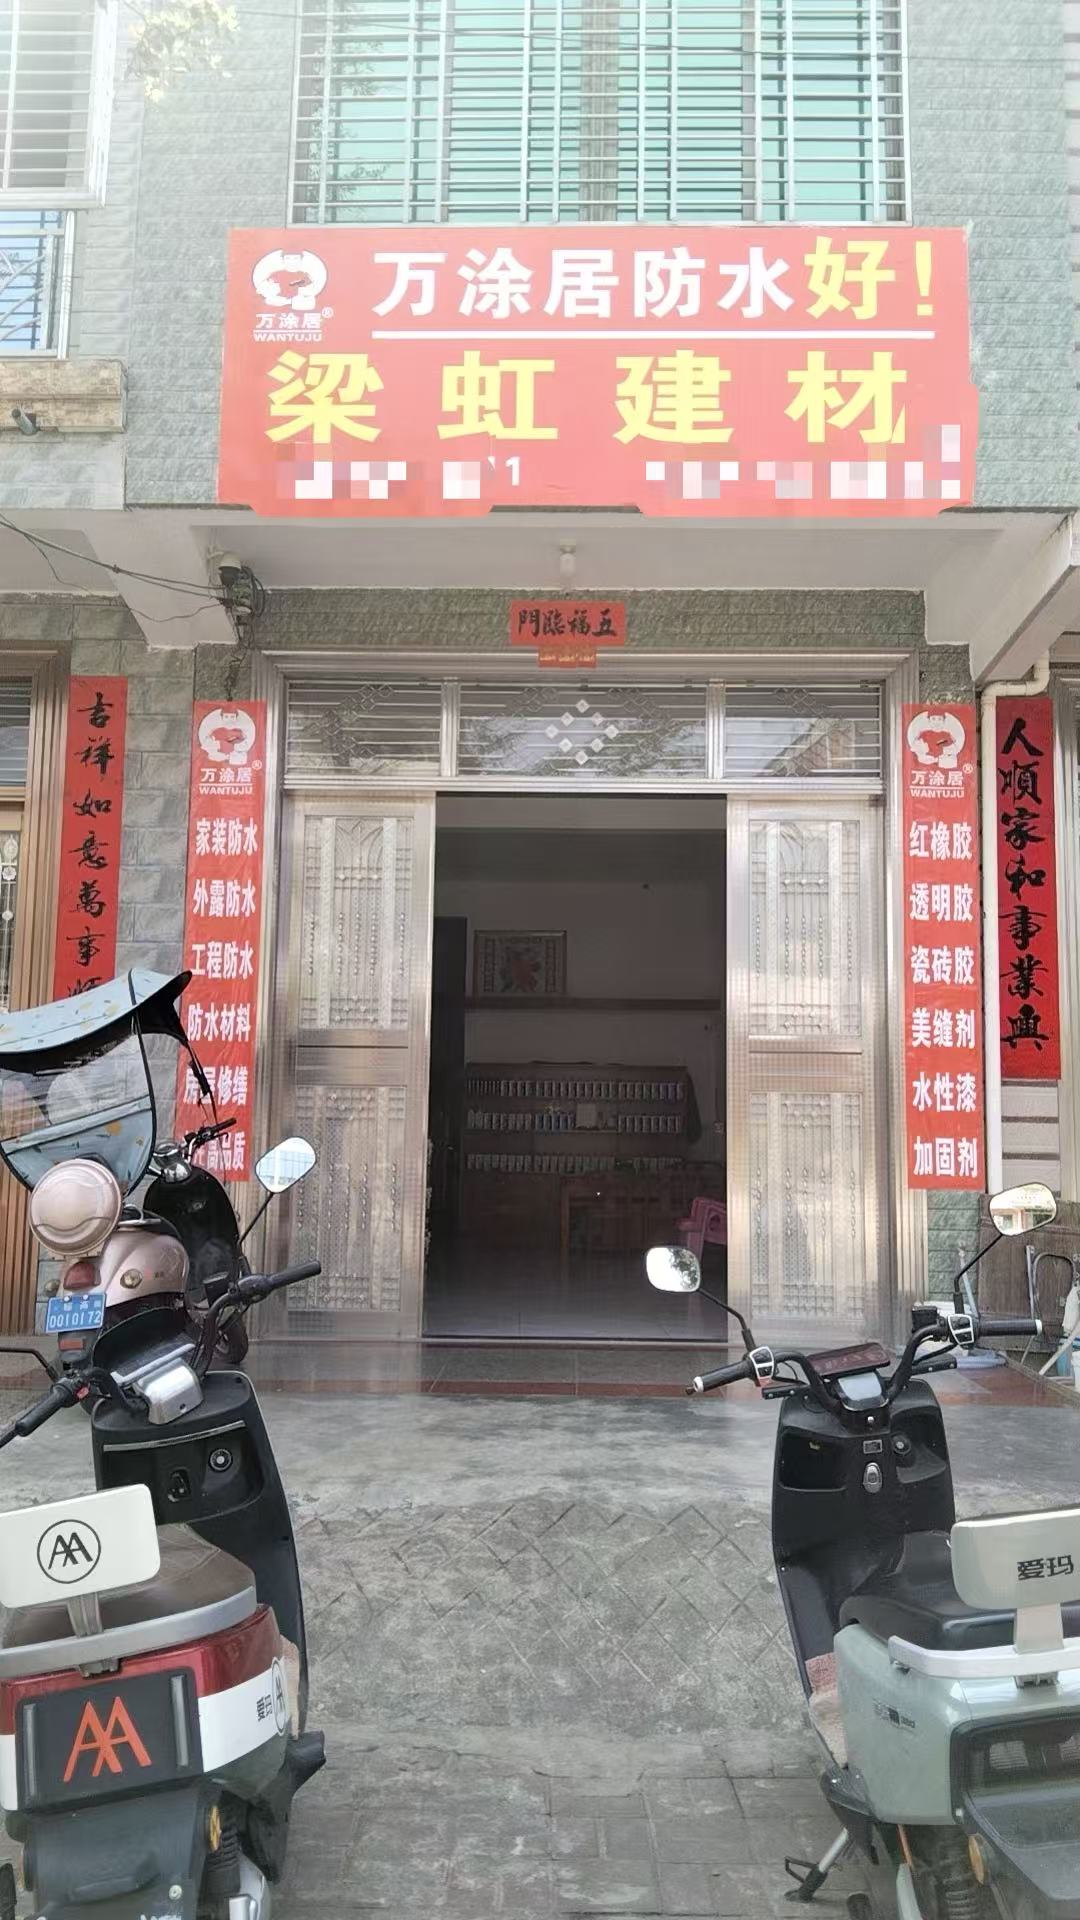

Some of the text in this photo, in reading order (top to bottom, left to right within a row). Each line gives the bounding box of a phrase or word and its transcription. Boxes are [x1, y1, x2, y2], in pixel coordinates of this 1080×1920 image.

[372, 236, 934, 318] 万涂居防水好！
[253, 333, 322, 342] WANTUJU
[255, 312, 322, 329] 万涂居
[265, 349, 906, 445] 梁虹建材
[199, 785, 253, 795] WANTUJU
[200, 767, 253, 783] 万涂居
[910, 789, 964, 798] WANTUJU
[911, 770, 964, 786] 万涂居
[195, 818, 258, 855] 家装防水
[909, 821, 973, 861] 红橡胶
[192, 878, 256, 918] 外露防水
[910, 883, 974, 922] 透明胶
[190, 940, 254, 979] 工程防水
[910, 945, 975, 985] 瓷砖胶
[186, 1002, 251, 1042] 防水材料
[911, 1008, 975, 1049] 美缝剂
[912, 1072, 977, 1113] 水性漆
[913, 1136, 978, 1178] 加固剂
[1017, 1555, 1074, 1580] 爱玛
